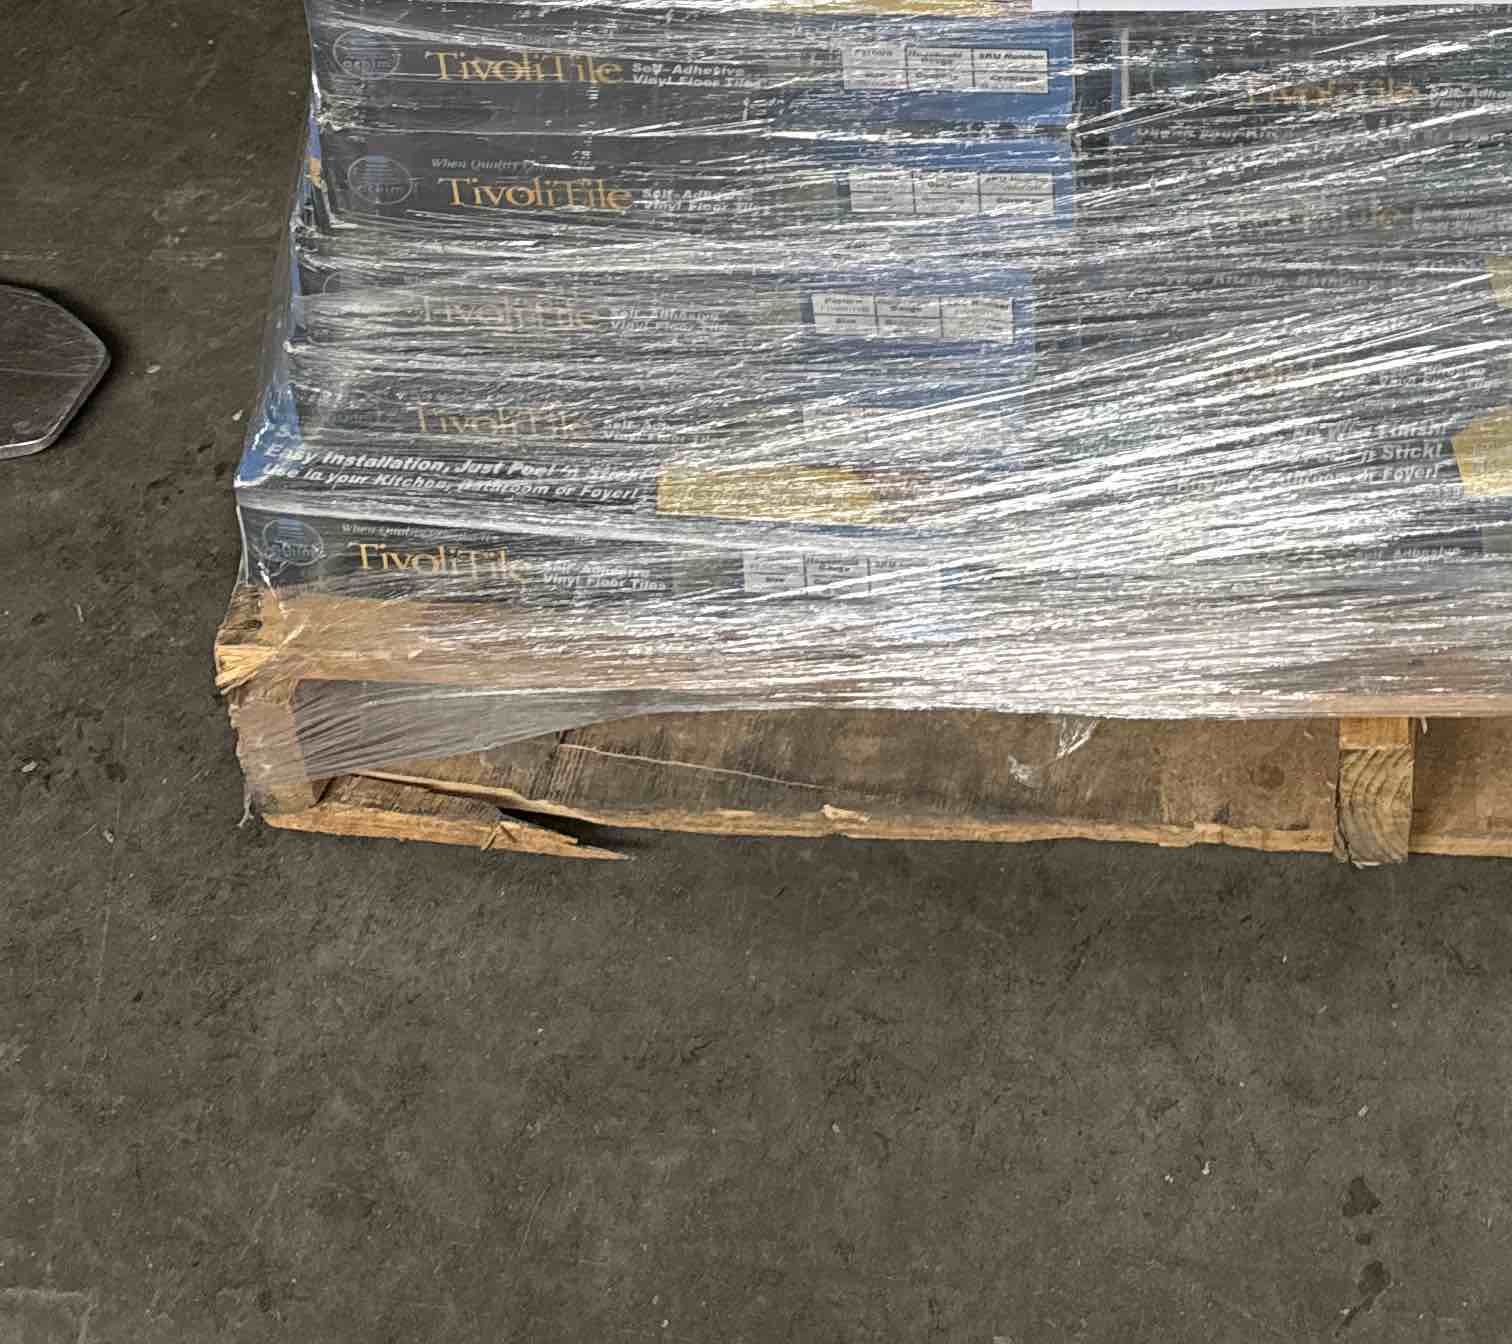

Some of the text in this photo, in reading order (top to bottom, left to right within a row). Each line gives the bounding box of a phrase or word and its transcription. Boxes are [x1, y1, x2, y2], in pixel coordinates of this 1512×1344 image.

[425, 50, 624, 84] TivoliTile
[631, 63, 745, 77] Self-Adhesive
[632, 73, 674, 87] Vinyl
[431, 158, 467, 170] When
[437, 176, 634, 210] TivoliTile
[265, 444, 554, 479] Easy Installation, Just Peel
[303, 467, 323, 482] in
[325, 471, 368, 490] your
[371, 472, 451, 492] Kitchen,
[555, 484, 575, 497] or
[542, 574, 584, 587] Vinyl
[587, 576, 628, 589] Floor
